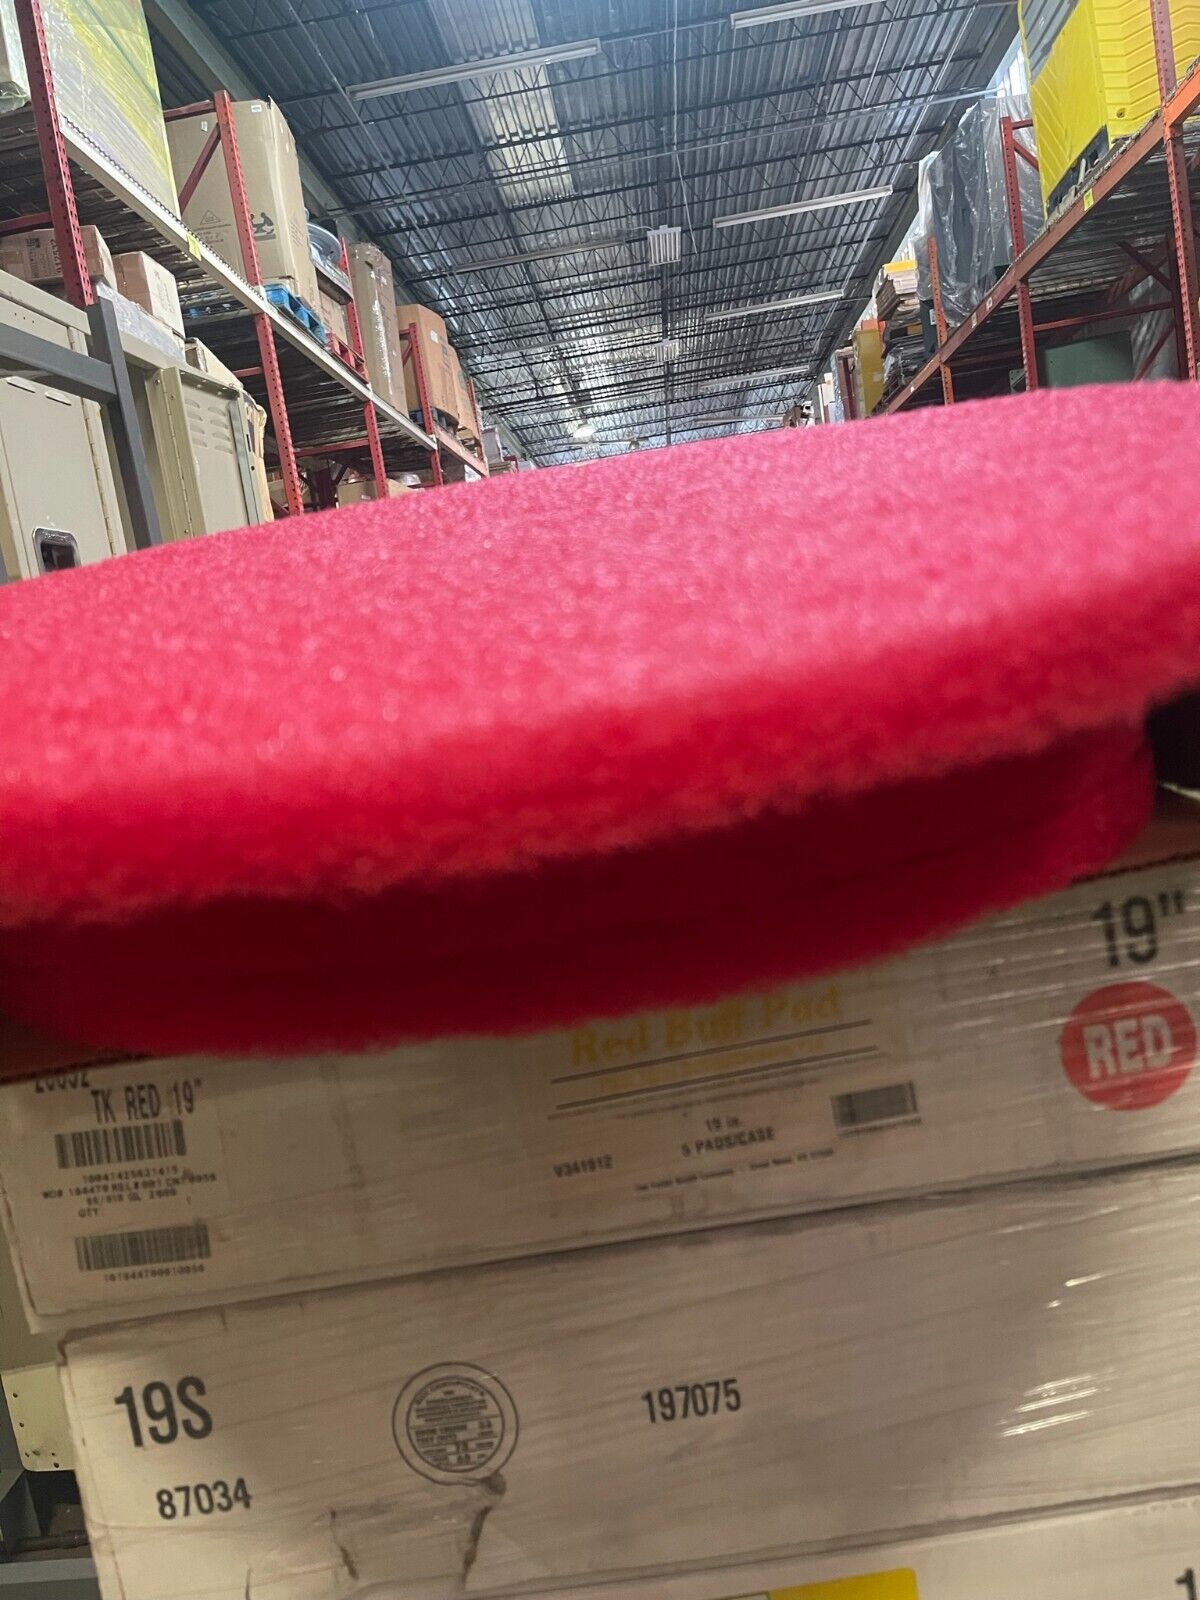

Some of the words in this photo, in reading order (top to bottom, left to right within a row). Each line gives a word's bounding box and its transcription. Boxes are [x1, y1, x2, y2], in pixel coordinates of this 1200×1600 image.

[1092, 890, 1185, 967] 19"
[1083, 1014, 1173, 1079] RED
[91, 1089, 117, 1123] TK
[124, 1083, 161, 1120] RED
[171, 1077, 203, 1115] 19"
[114, 1376, 213, 1448] 19S
[640, 1378, 742, 1424] 197075
[156, 1477, 253, 1520] 87034
